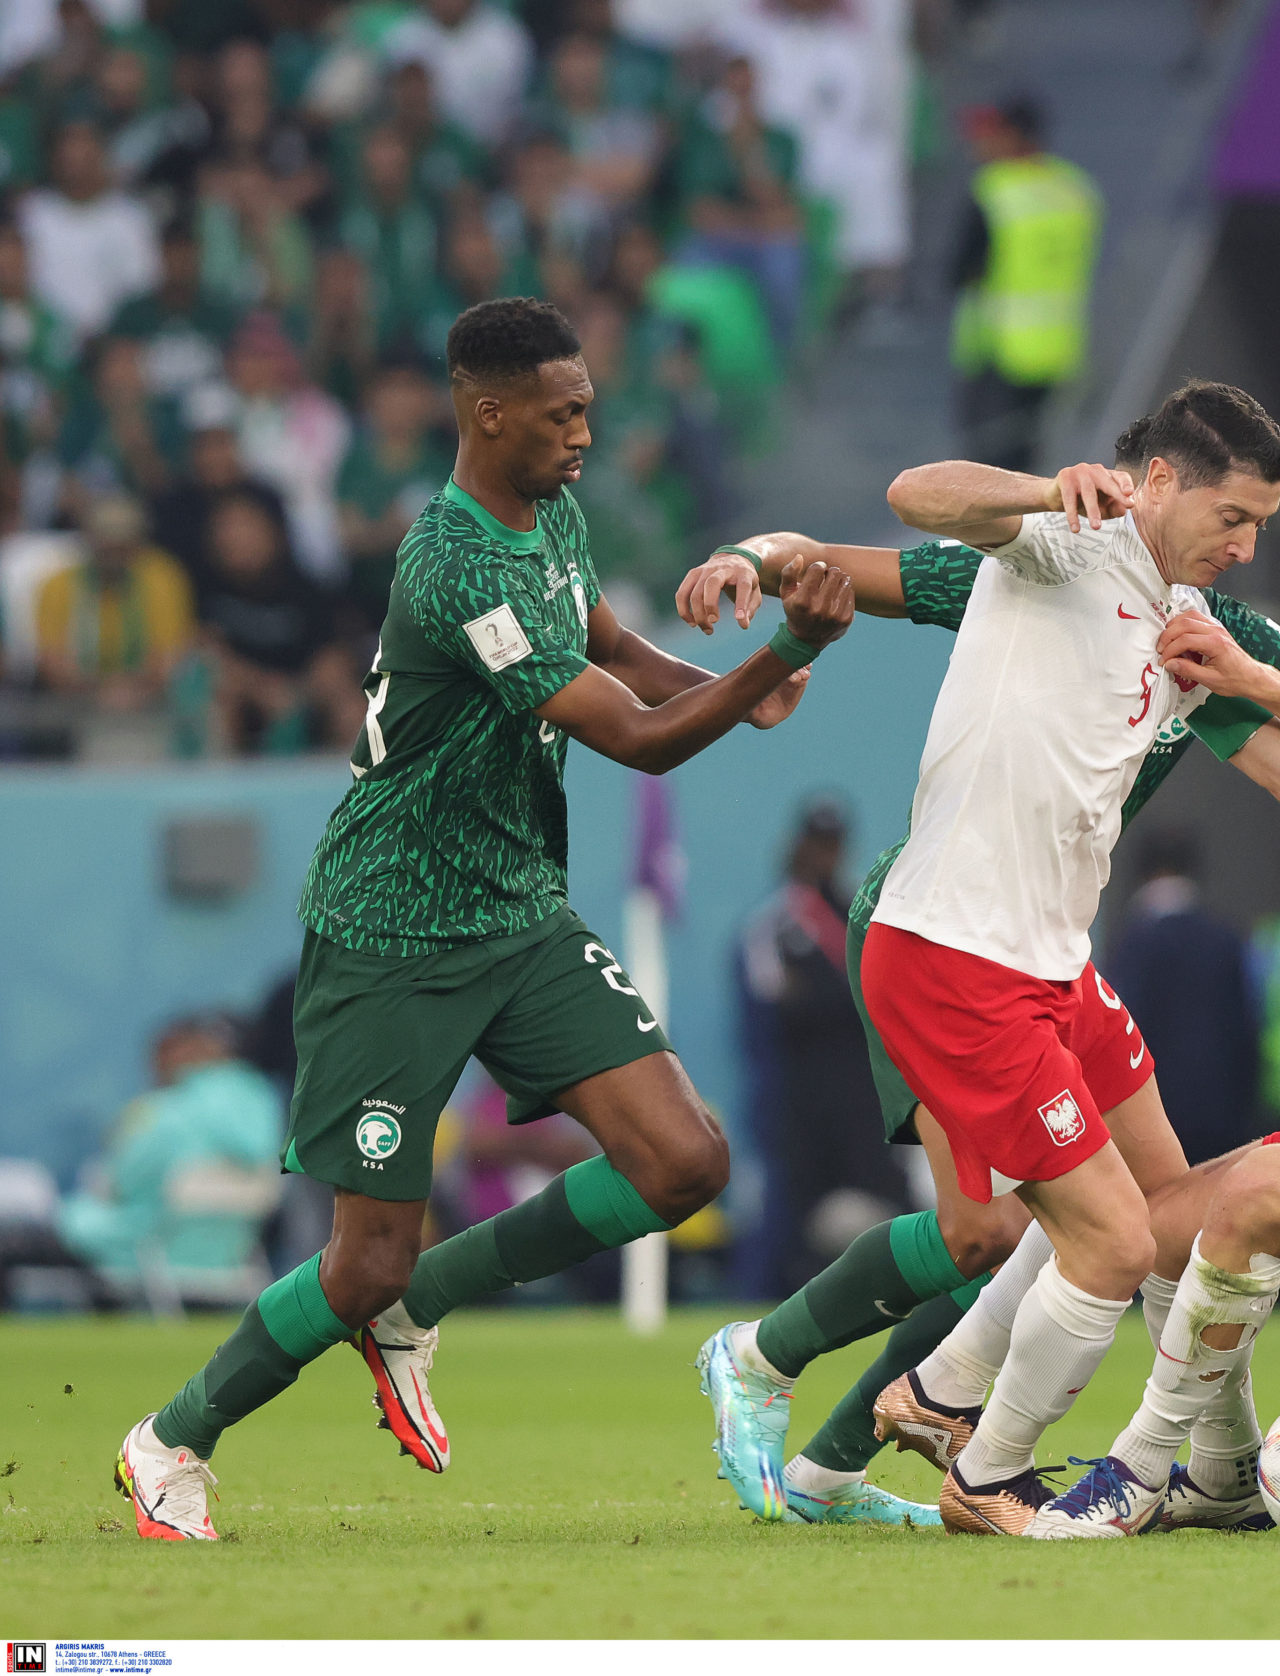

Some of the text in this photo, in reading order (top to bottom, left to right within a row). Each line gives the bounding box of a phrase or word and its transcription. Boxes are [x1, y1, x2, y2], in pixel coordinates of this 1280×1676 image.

[1151, 746, 1173, 754] KSA
[584, 942, 640, 997] 2
[362, 1098, 407, 1115] السعودية
[362, 1160, 384, 1171] KSA
